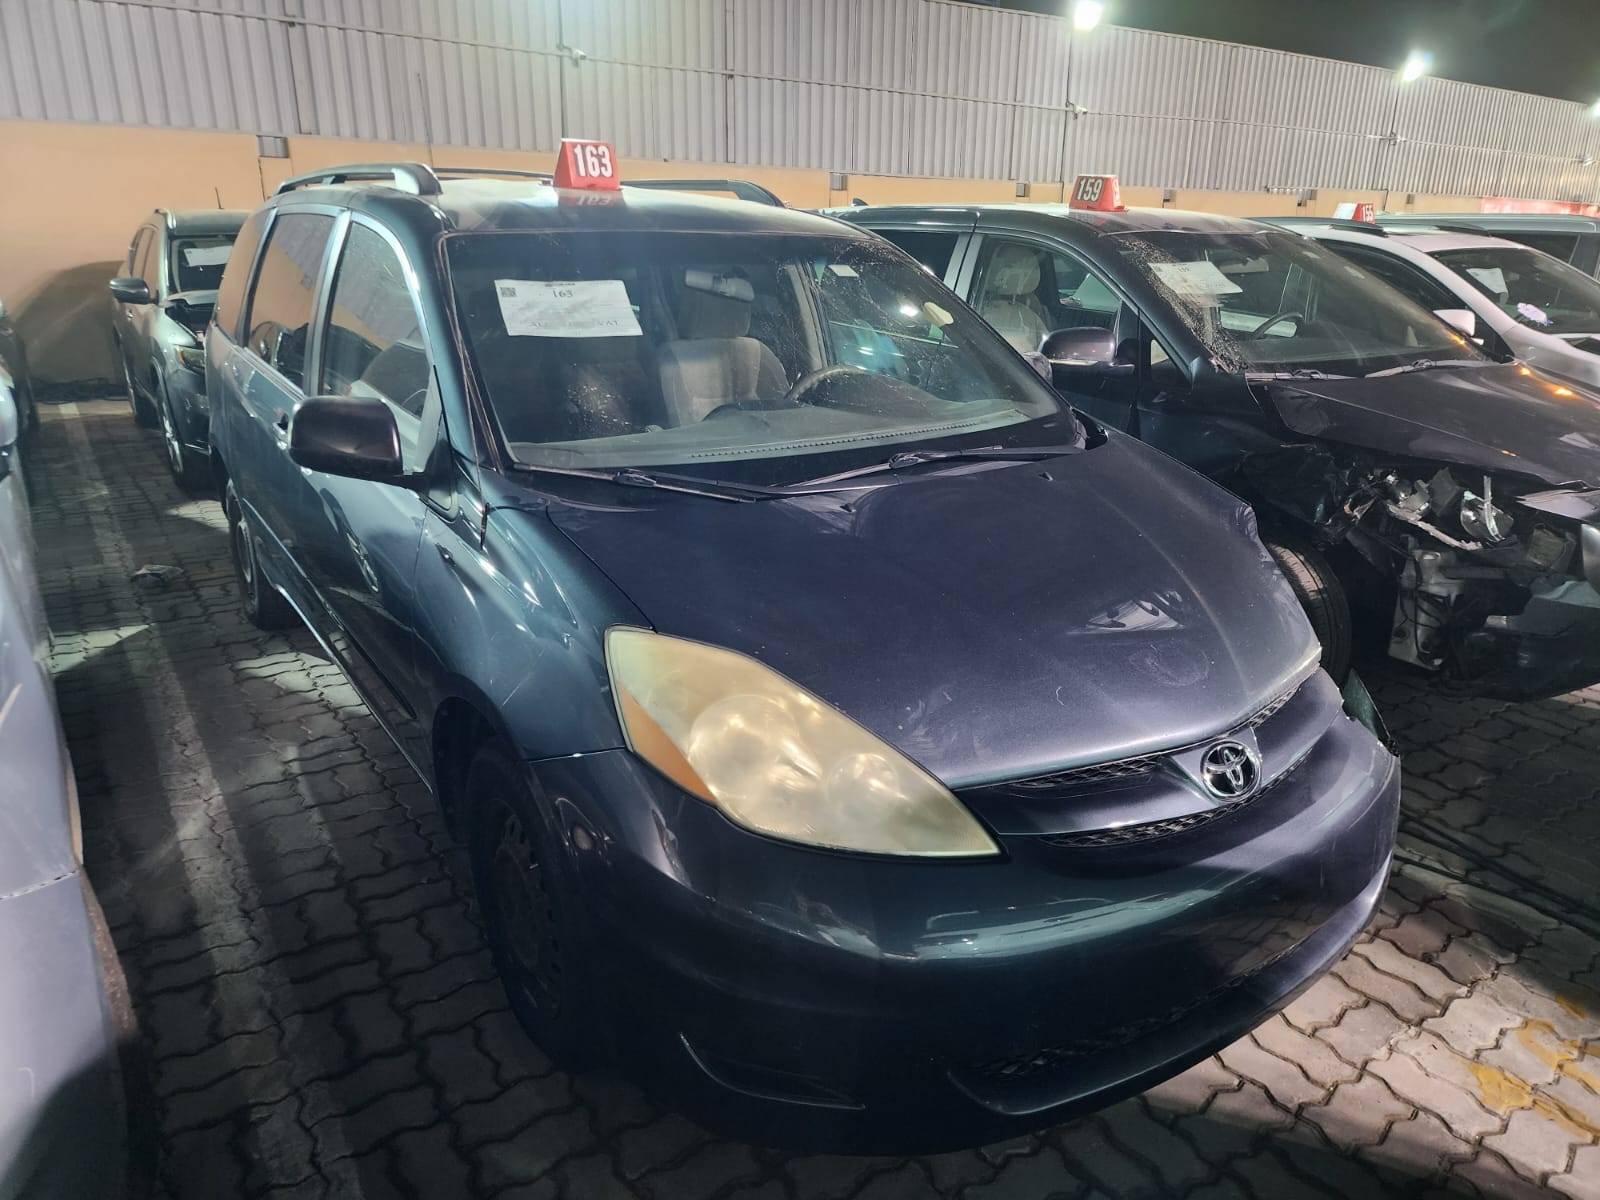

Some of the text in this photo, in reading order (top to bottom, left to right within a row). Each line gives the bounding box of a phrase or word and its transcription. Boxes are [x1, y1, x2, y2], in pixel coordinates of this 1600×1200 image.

[574, 144, 613, 178] 163
[1077, 178, 1103, 202] 159
[552, 289, 574, 298] 163
